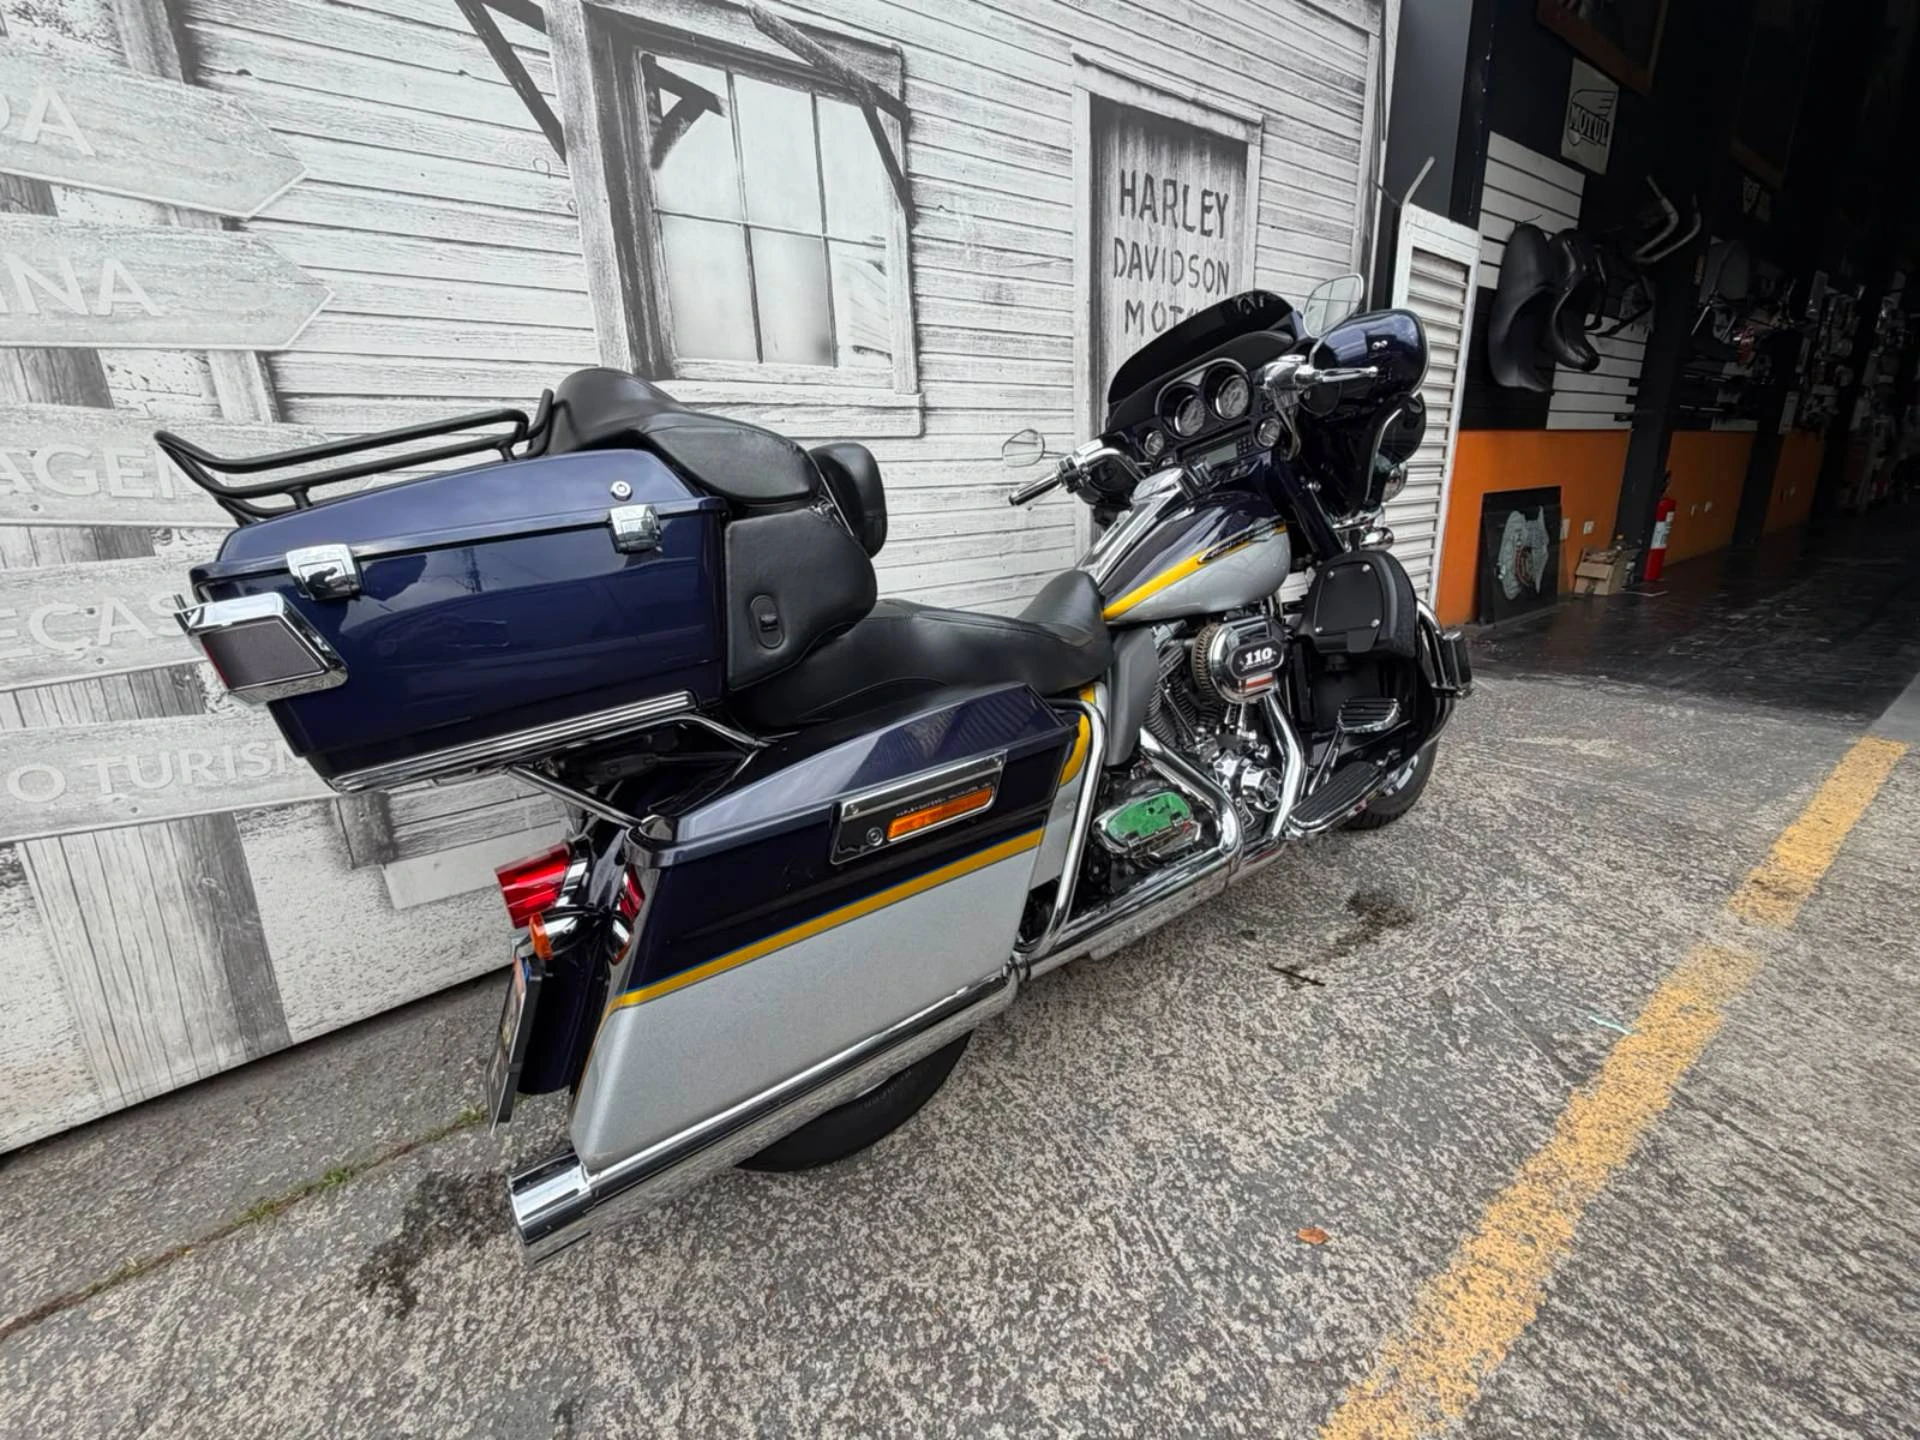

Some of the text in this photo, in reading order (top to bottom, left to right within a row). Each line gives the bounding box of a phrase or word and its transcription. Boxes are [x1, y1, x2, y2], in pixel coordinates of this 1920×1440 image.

[0, 85, 97, 157] A
[1568, 102, 1610, 145] MOTUL
[1119, 169, 1229, 239] HARLEY
[1113, 236, 1230, 296] DAVIDSON
[1124, 298, 1200, 337] MOT
[1245, 646, 1273, 666] 110
